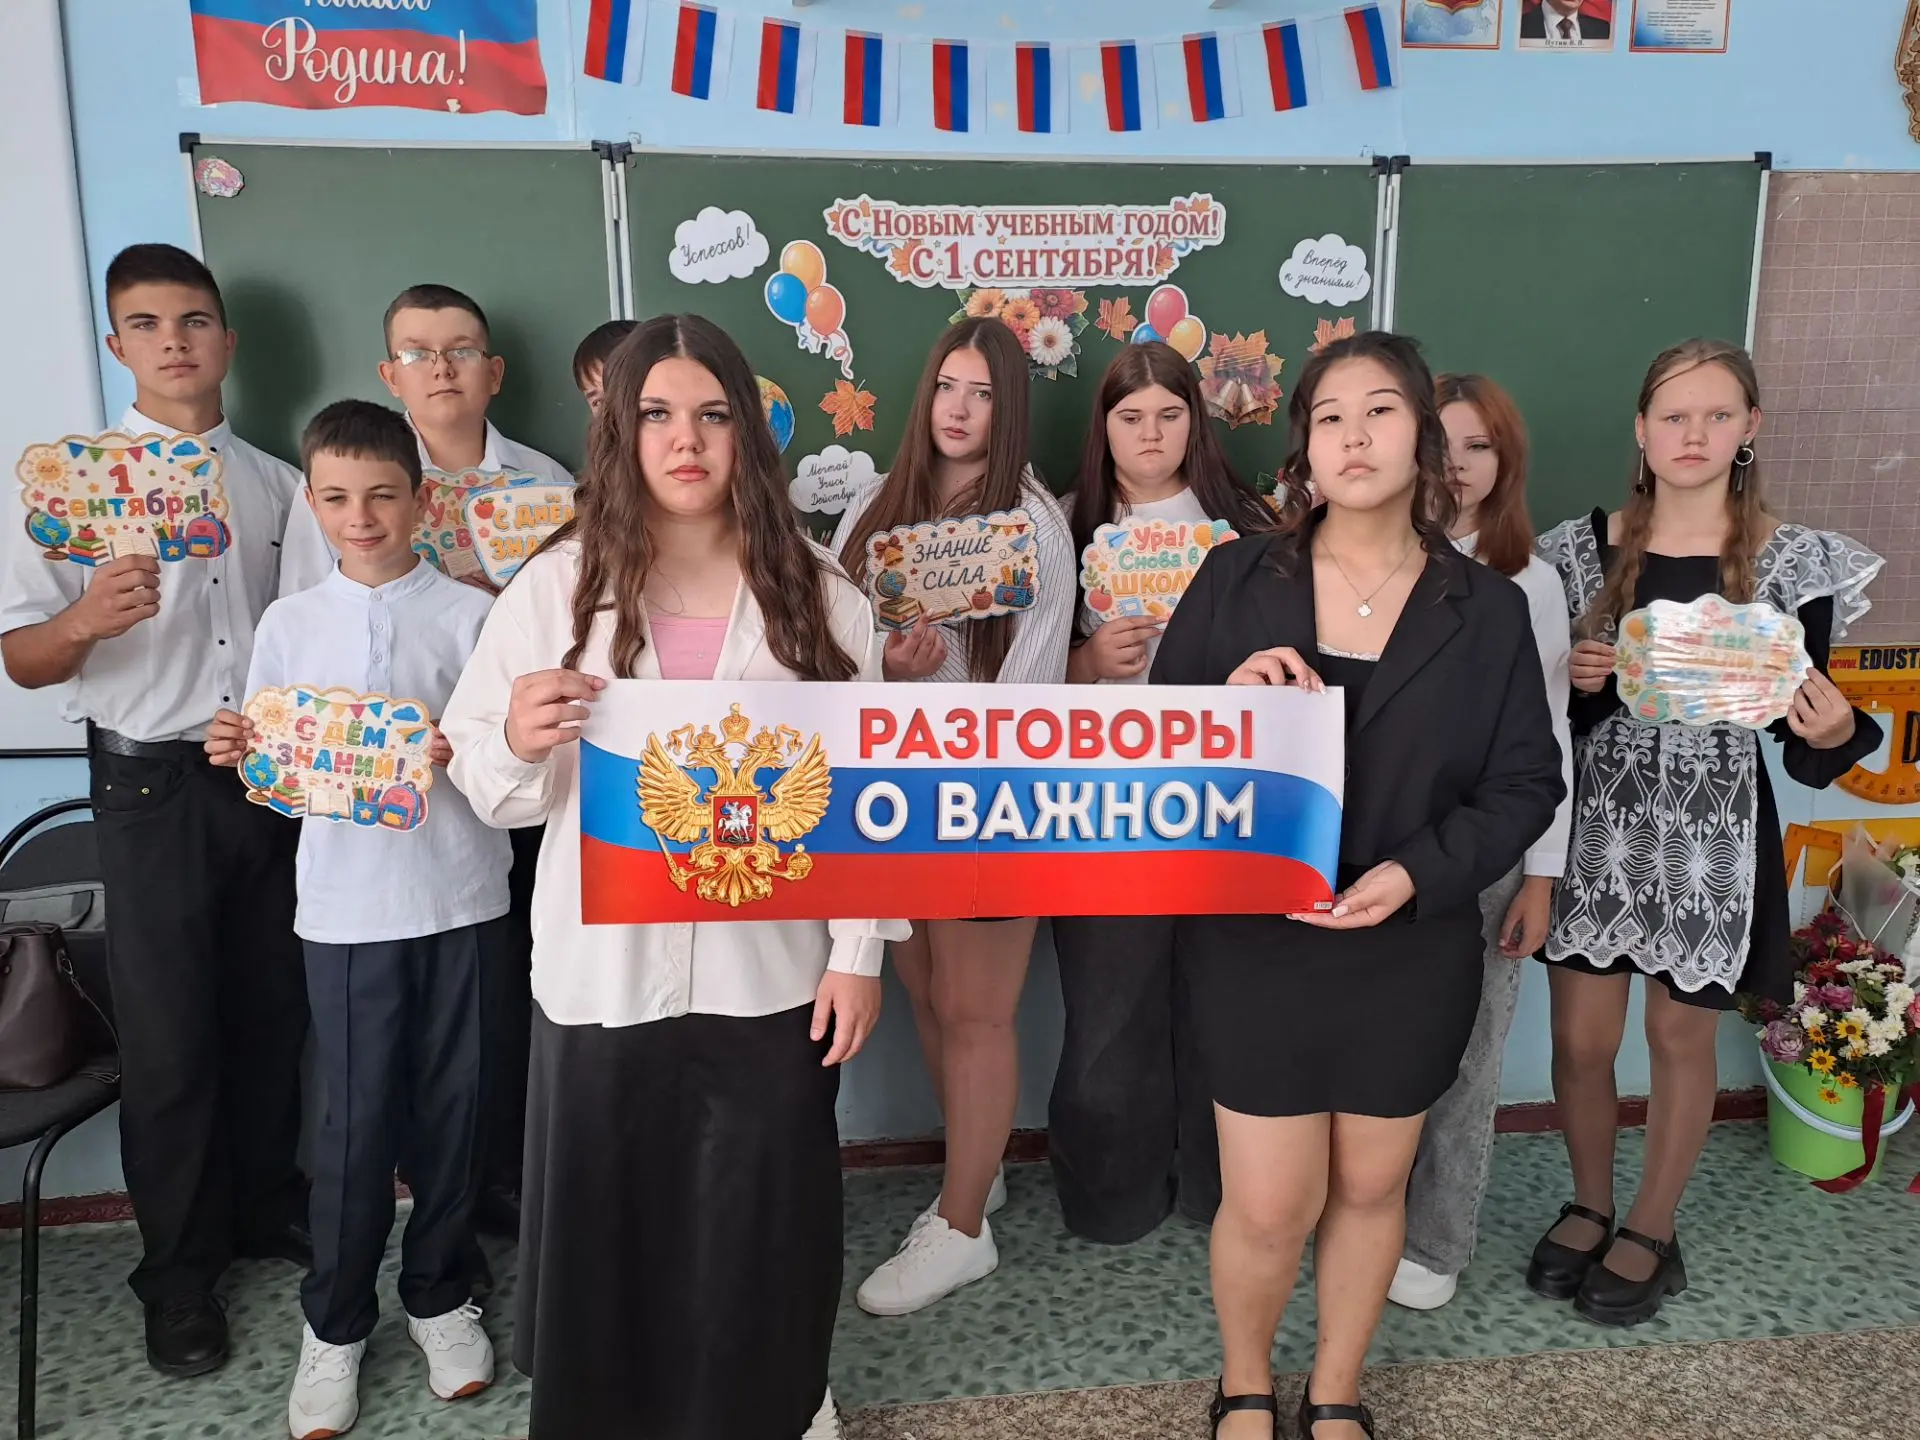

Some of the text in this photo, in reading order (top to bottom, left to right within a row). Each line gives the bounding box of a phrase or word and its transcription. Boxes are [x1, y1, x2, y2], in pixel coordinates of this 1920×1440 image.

[261, 17, 466, 104] Родина!
[842, 208, 861, 237] С
[680, 222, 750, 267] Успехов!
[912, 241, 1155, 279] С 1 СЕНТЯБРЯ!
[108, 463, 135, 495] 1
[47, 487, 209, 521] сентября!
[429, 501, 467, 528] УЧ
[494, 509, 509, 530] С
[489, 534, 547, 560] ЗНА
[912, 535, 993, 564] ЗНАНИЕ
[1133, 524, 1187, 552] Ура!
[923, 565, 986, 591] СИЛА
[1859, 648, 1920, 671] EDUST
[295, 715, 317, 742] С
[859, 707, 1253, 760] РАЗГОВОРЫ
[275, 742, 406, 782] ЗНАНИЙ!
[855, 780, 1255, 842] О ВАЖНОМ
